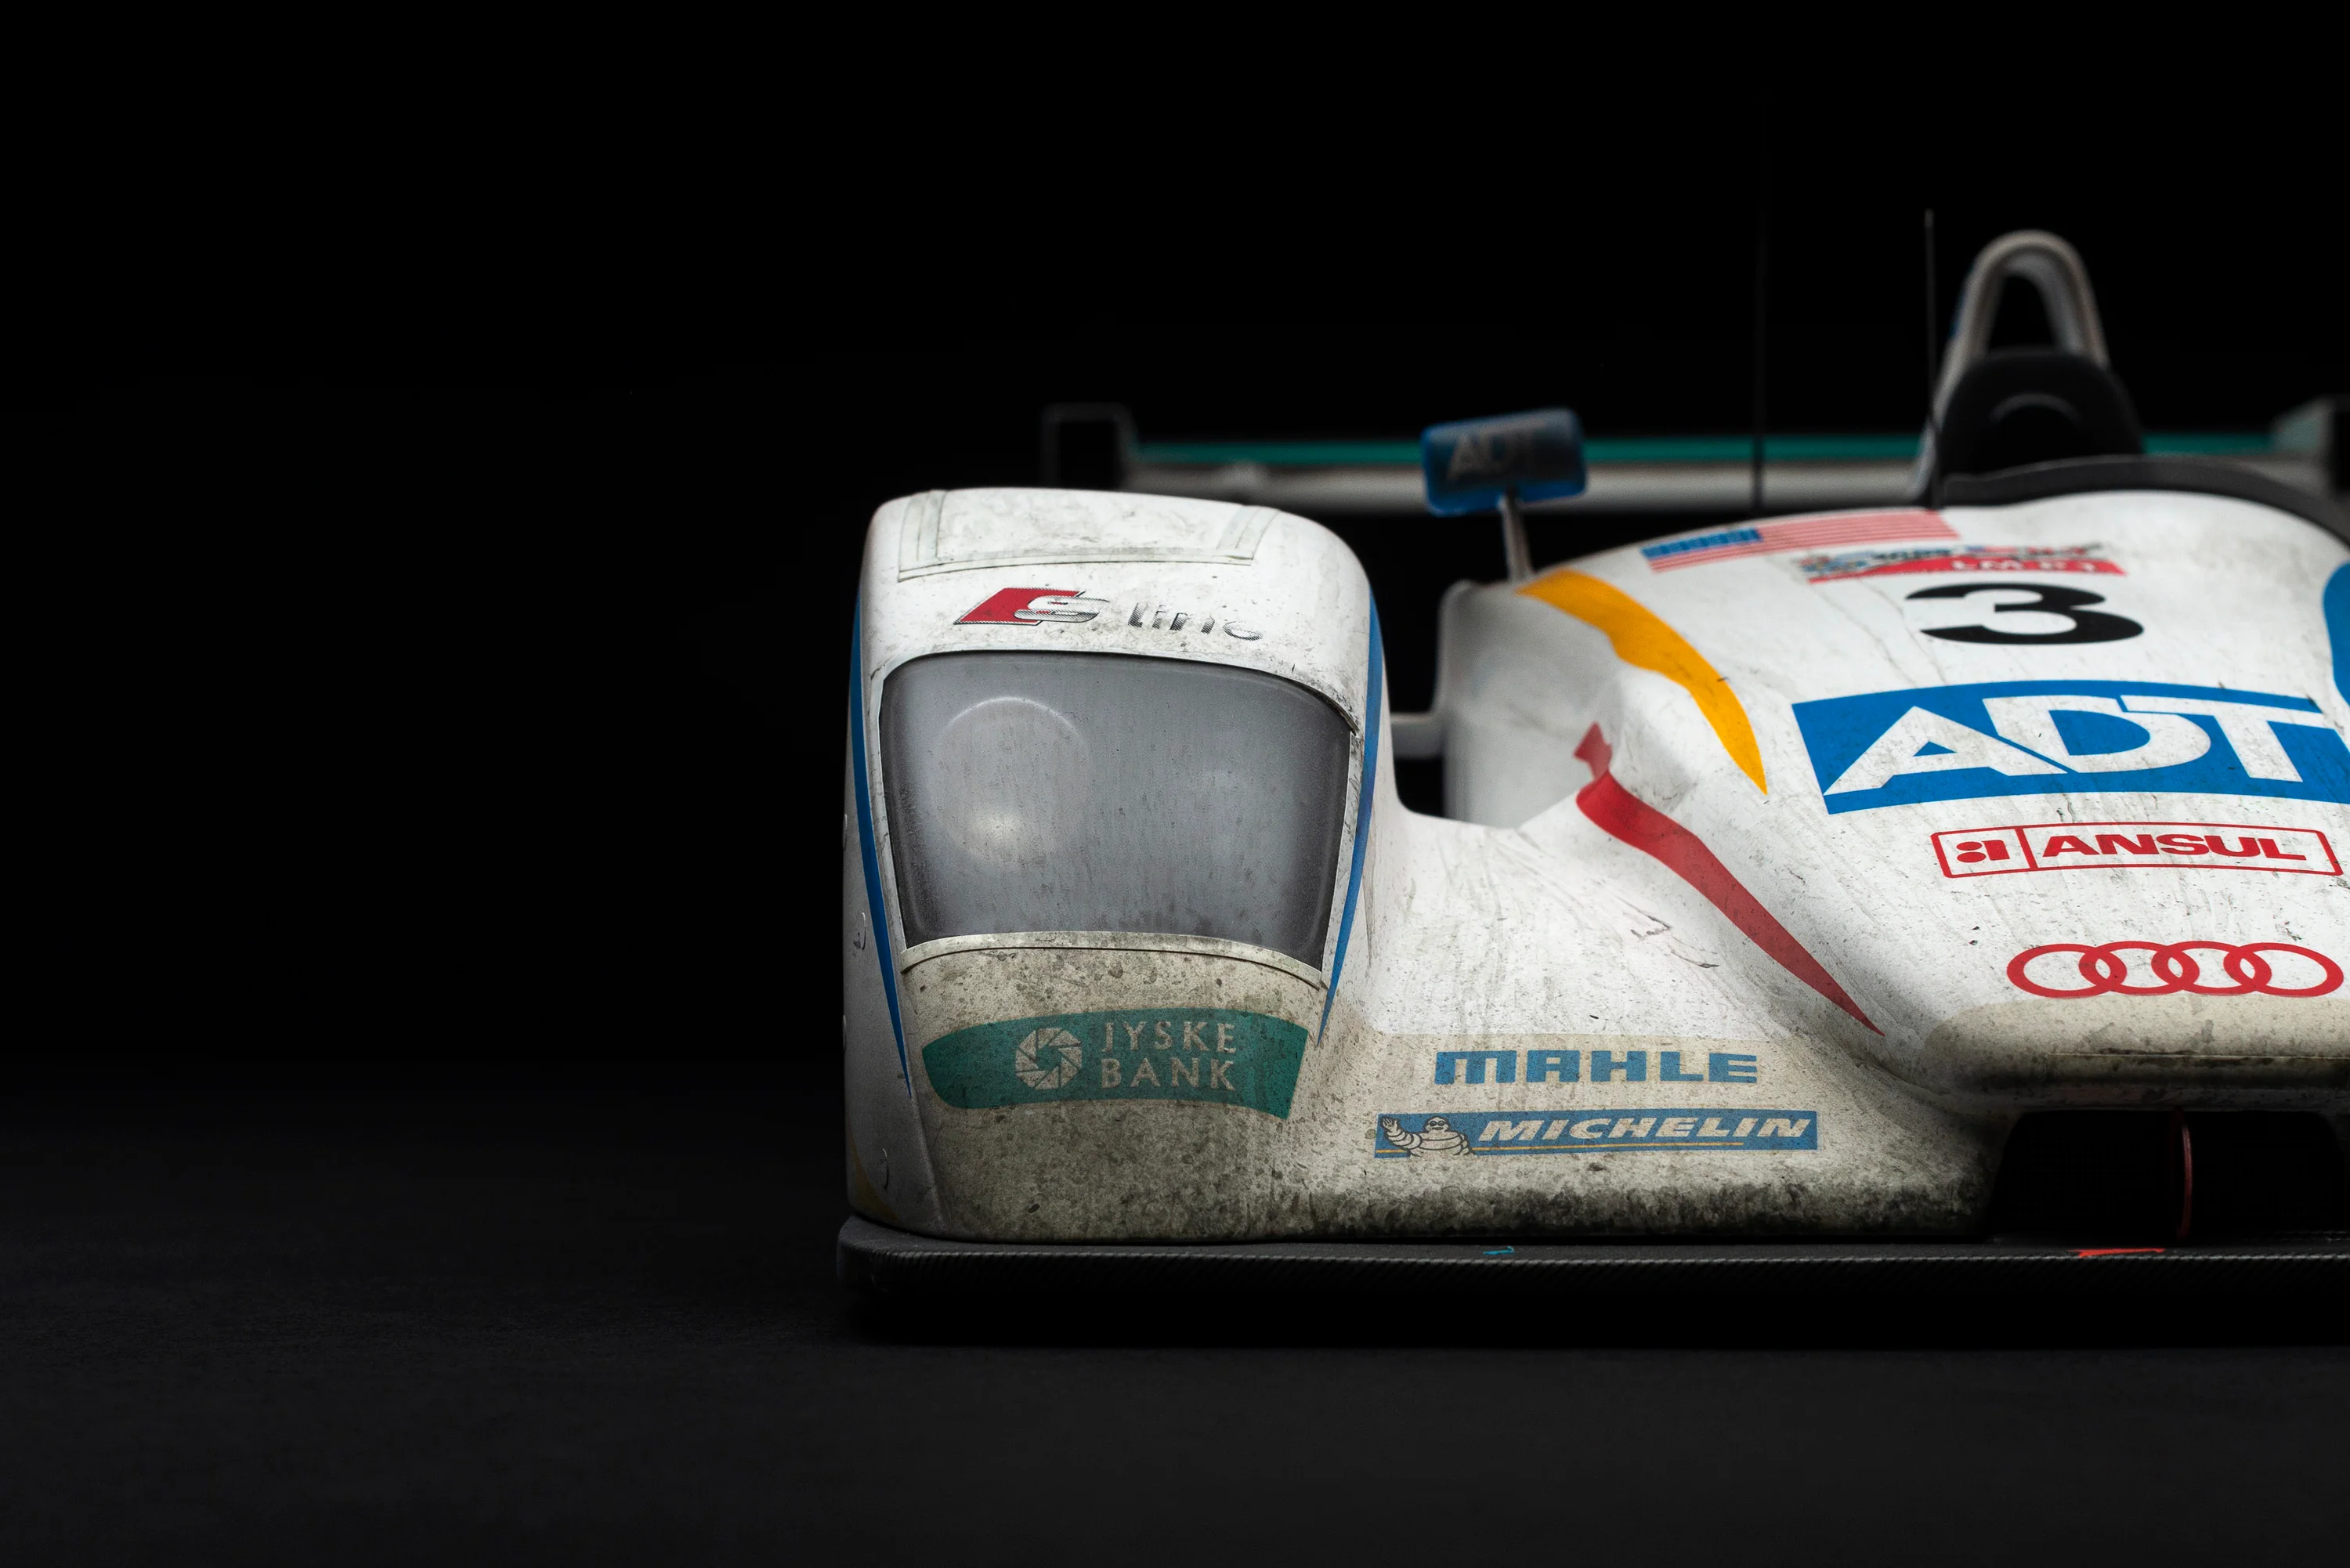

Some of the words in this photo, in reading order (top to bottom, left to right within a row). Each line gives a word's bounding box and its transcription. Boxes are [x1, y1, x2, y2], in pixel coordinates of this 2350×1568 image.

[1906, 583, 2144, 645] 3
[1824, 694, 2337, 796] ADT
[2042, 833, 2307, 861] ANSUL
[1101, 1021, 1237, 1053] JYSKE
[1101, 1057, 1235, 1091] BANK
[1434, 1050, 1758, 1086] MAHLE
[1477, 1116, 1811, 1142] MICHELIN
